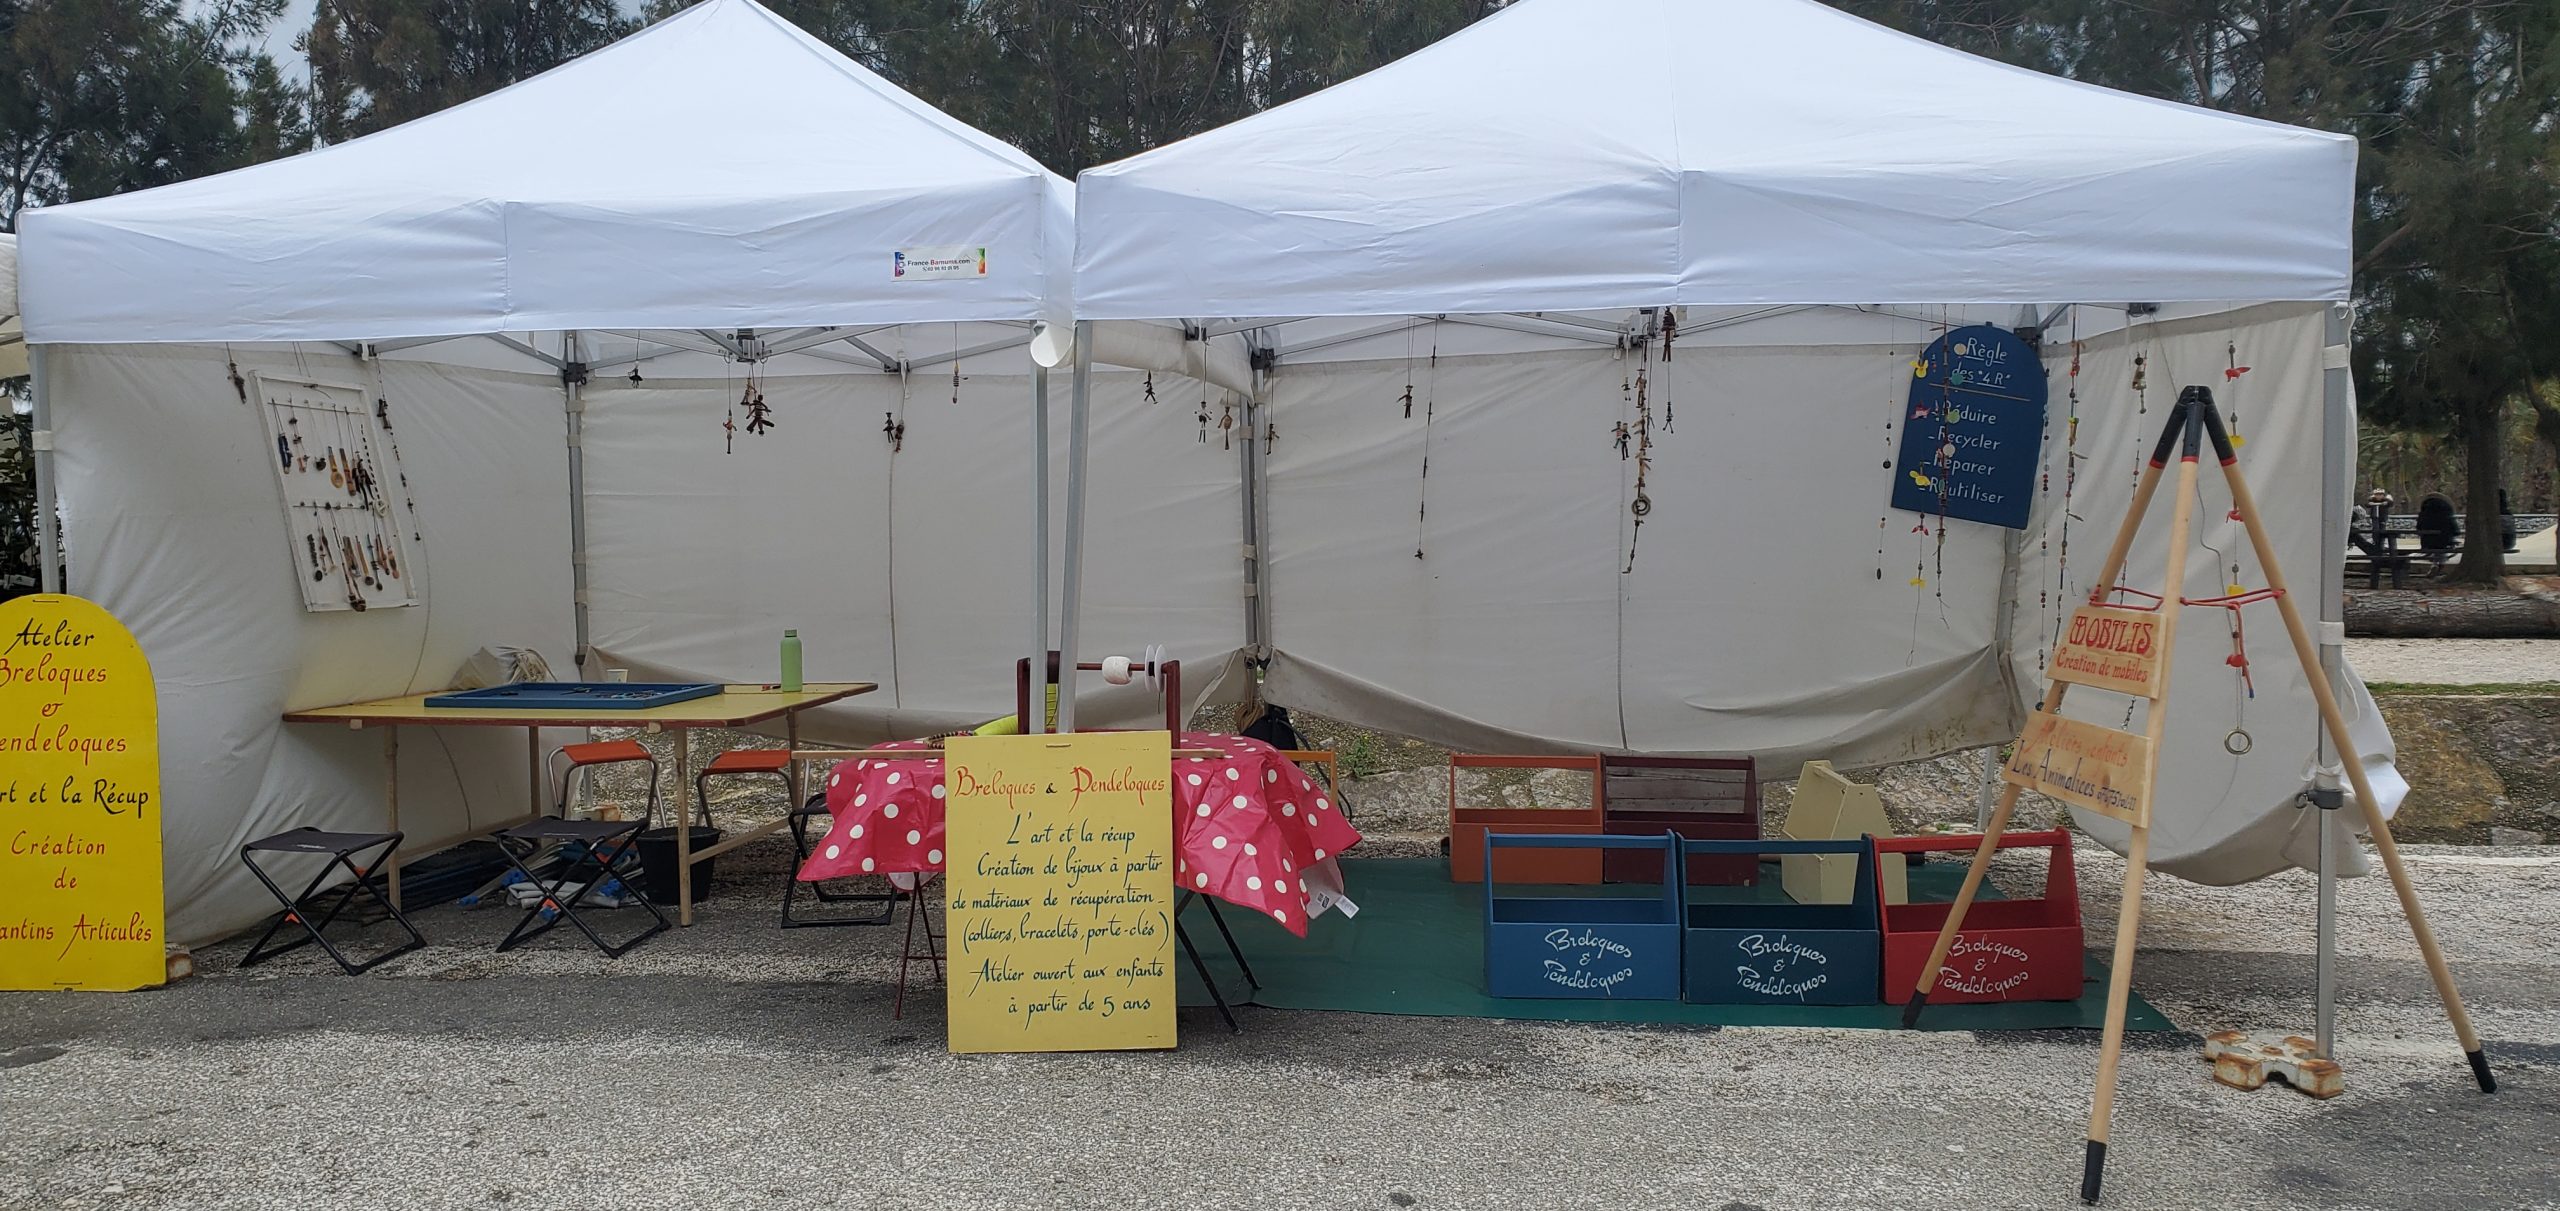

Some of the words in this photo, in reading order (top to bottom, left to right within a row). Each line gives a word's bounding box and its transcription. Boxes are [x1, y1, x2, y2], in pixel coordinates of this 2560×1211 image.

[1965, 337, 2008, 367] Règle
[4, 617, 95, 655] Atelier
[2069, 615, 2153, 655] MOBILIS
[0, 652, 107, 695] Breloques
[2098, 657, 2109, 677] de
[2112, 657, 2148, 683] mobiles
[0, 723, 127, 766] endeloques
[2011, 739, 2033, 777] Les
[29, 783, 48, 803] et
[61, 775, 82, 804] la
[93, 778, 149, 819] Récup
[953, 765, 1037, 810] Breloques
[1045, 782, 1058, 795] &
[1068, 766, 1166, 814] Pendeloques
[11, 830, 106, 855] Création
[1058, 823, 1075, 844] et
[1081, 818, 1094, 843] la
[1100, 826, 1136, 854] récup
[54, 867, 77, 889] de
[977, 852, 1034, 877] Création
[1043, 861, 1058, 876] de
[1065, 846, 1107, 889] bijoux
[1109, 856, 1119, 873] à
[1123, 850, 1163, 886] partir
[952, 889, 966, 910] de
[972, 888, 1032, 909] matériaux
[1043, 888, 1058, 907] de
[1070, 883, 1154, 920] récupération
[0, 918, 54, 940] antins
[57, 911, 152, 961] Articulés
[962, 917, 1017, 955] (colliers,
[1544, 928, 1632, 959] Breloques
[1738, 934, 1827, 965] Breloques
[968, 954, 1024, 998] Atelier
[1033, 959, 1075, 981] ouvert
[1083, 965, 1107, 977] aux
[1115, 957, 1164, 988] enfants
[1543, 957, 1633, 996] Pendeloques
[1579, 952, 1591, 966] &
[1773, 958, 1785, 972] &
[1974, 958, 1987, 972] &
[1737, 964, 1827, 1002] Pendeloques
[1939, 965, 2029, 1000] Pendeloques
[1007, 997, 1018, 1014] à
[1024, 989, 1068, 1031] partir
[1078, 989, 1095, 1011] de
[1102, 996, 1114, 1017] 5
[1123, 997, 1151, 1010] ans
